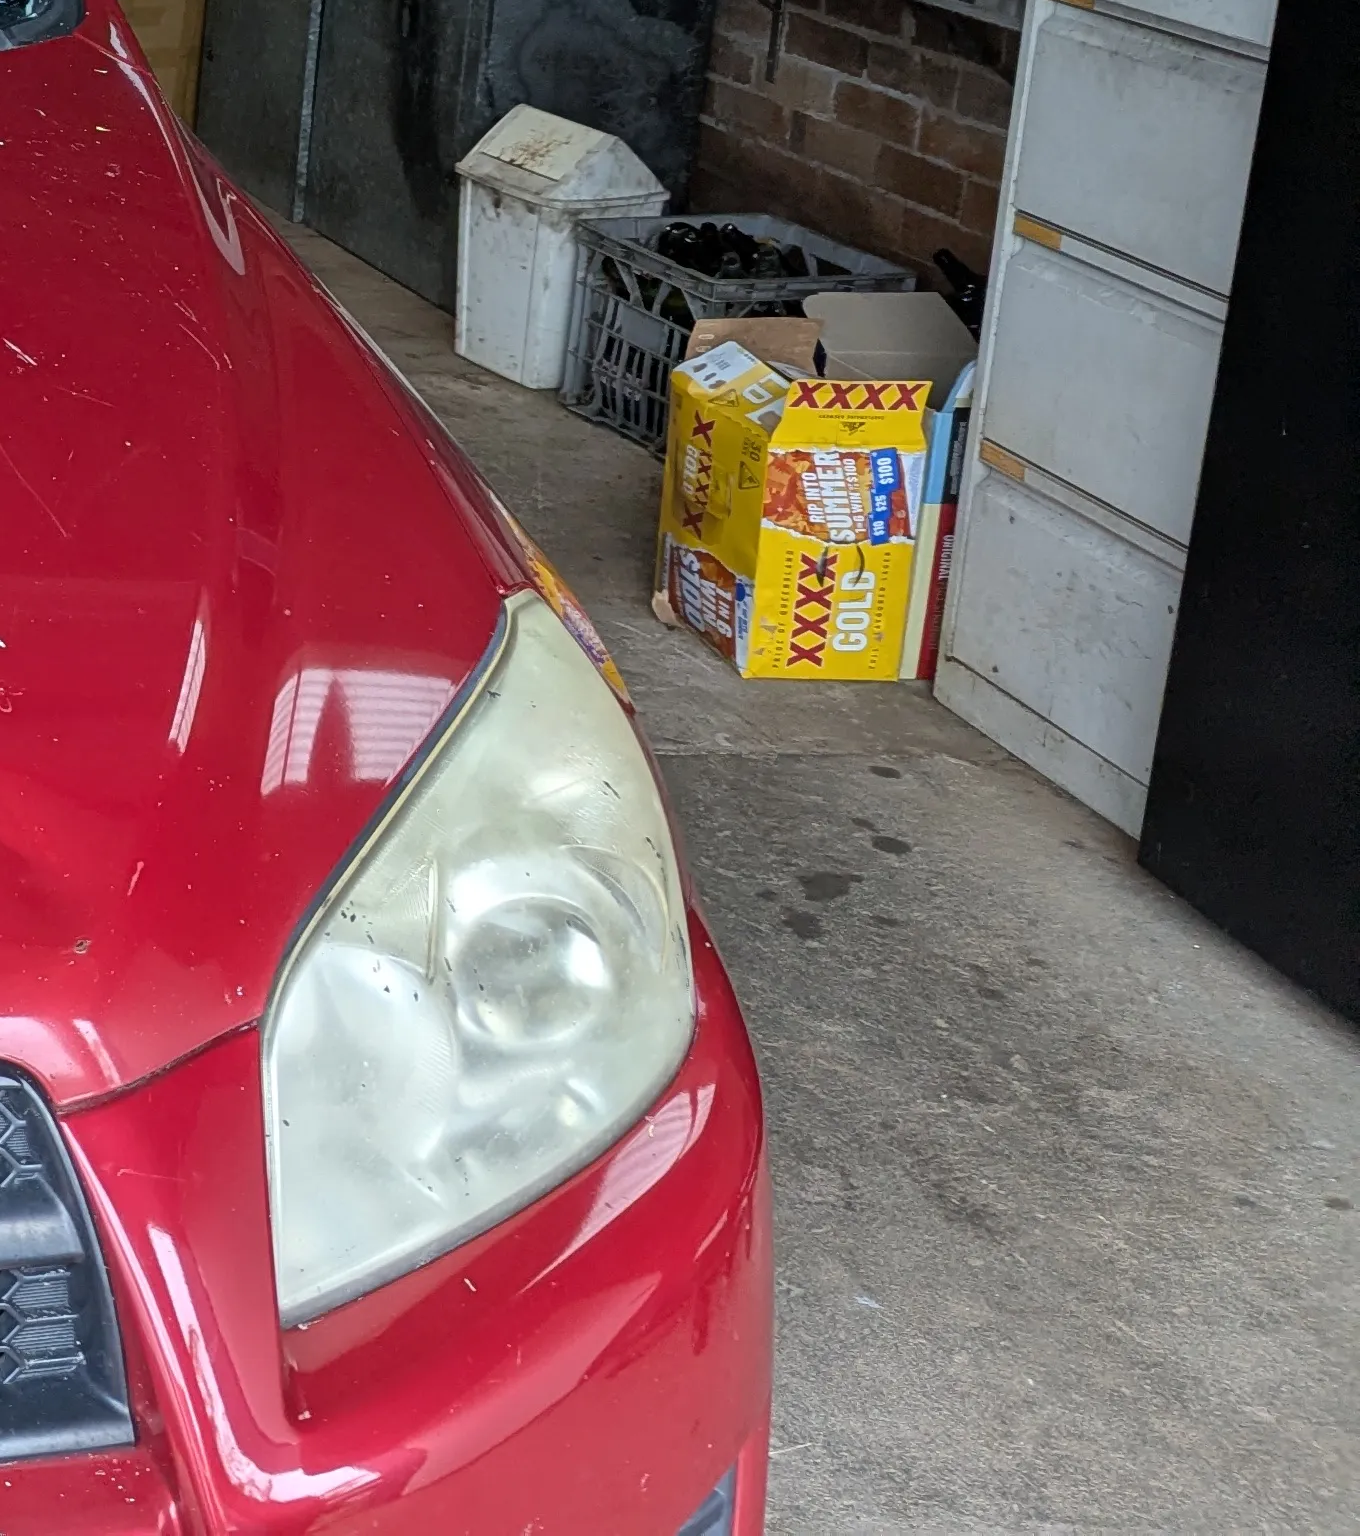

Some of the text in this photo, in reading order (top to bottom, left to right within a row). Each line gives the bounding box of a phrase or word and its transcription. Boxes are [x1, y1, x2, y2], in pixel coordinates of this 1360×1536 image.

[788, 381, 927, 411] XXXX
[749, 441, 762, 462] 30
[843, 458, 858, 483] $100
[877, 457, 894, 485] $100
[802, 472, 826, 523] RIP INTO
[814, 450, 857, 543] SUMMER
[849, 493, 863, 515] WIN
[873, 520, 884, 537] $10
[680, 548, 706, 632] $100
[700, 579, 717, 629] WIN
[716, 586, 732, 638] 1 IN 6
[772, 550, 794, 669] PRIDE OF QUEENSLAND
[785, 551, 840, 669] XXXX
[832, 570, 876, 653] GOLD
